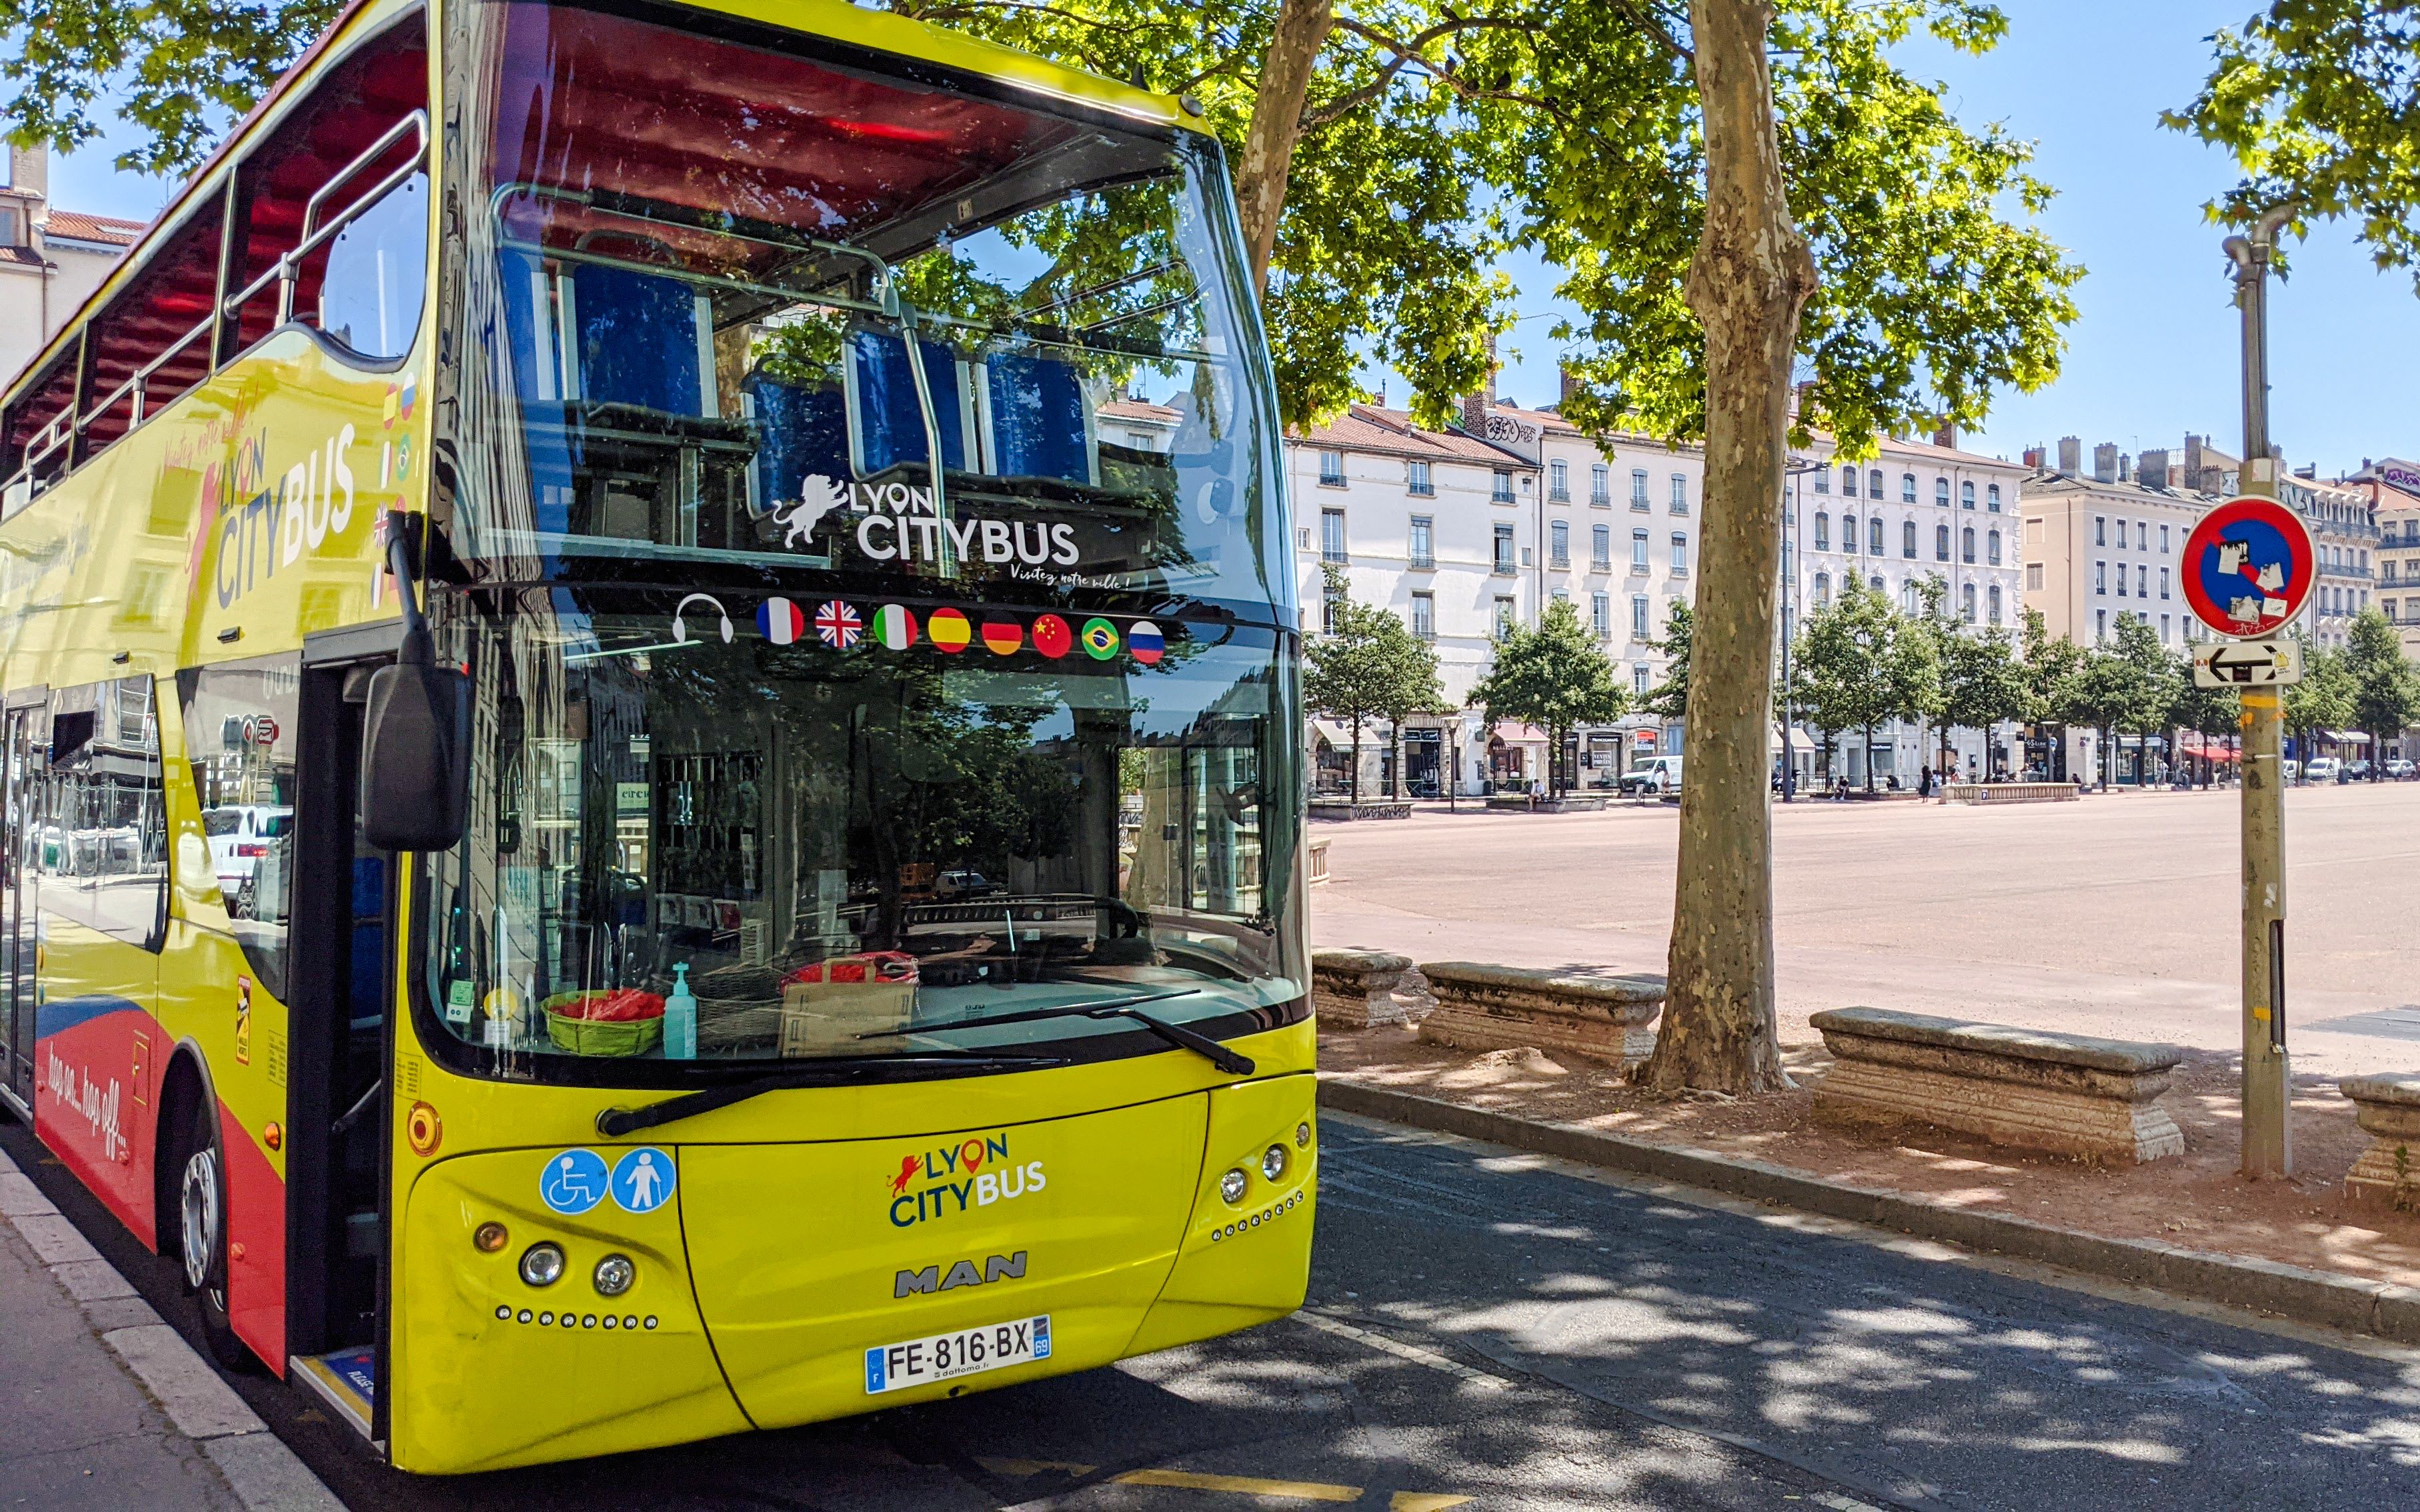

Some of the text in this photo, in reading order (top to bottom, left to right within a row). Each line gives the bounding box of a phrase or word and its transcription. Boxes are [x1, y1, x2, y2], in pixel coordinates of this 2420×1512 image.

[220, 425, 267, 518] LYON
[217, 423, 355, 610] CITYBUS
[848, 482, 935, 515] LYON
[857, 515, 1080, 565] CITYBUS
[1010, 563, 1058, 587] Visitez
[1060, 571, 1090, 587] notre
[1092, 573, 1122, 590] ville
[49, 1041, 63, 1107] hop
[83, 1065, 101, 1137] hop
[926, 1133, 1008, 1180] LYON
[890, 1161, 1047, 1228] CITYBUS
[894, 1250, 1028, 1299] MAN
[888, 1322, 1030, 1379] FE-816-BX
[942, 1362, 990, 1377] dattoma.fr
[1035, 1339, 1048, 1355] 69
[873, 1373, 880, 1384] F
